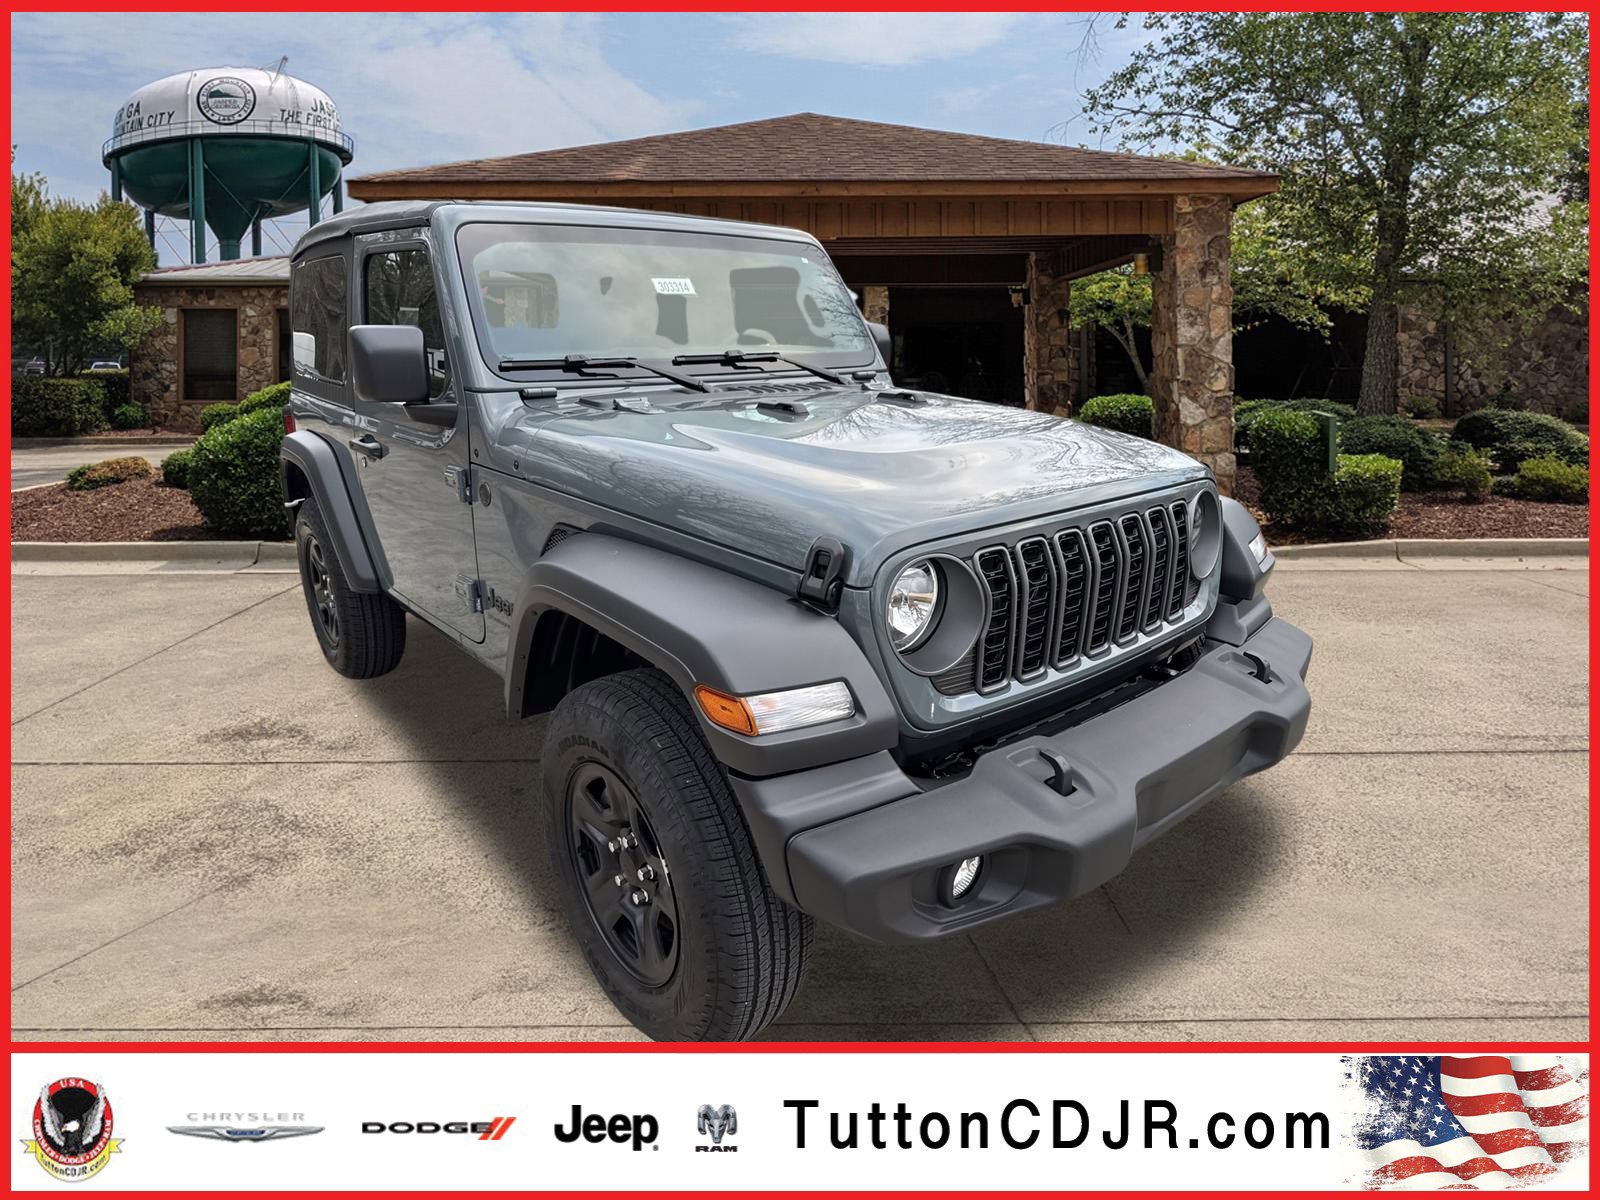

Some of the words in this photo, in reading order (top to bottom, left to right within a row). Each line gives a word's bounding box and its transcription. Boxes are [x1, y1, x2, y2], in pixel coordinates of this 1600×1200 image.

[127, 100, 141, 119] GA
[280, 108, 302, 124] THE
[147, 110, 176, 127] CITY
[657, 281, 691, 293] 303314
